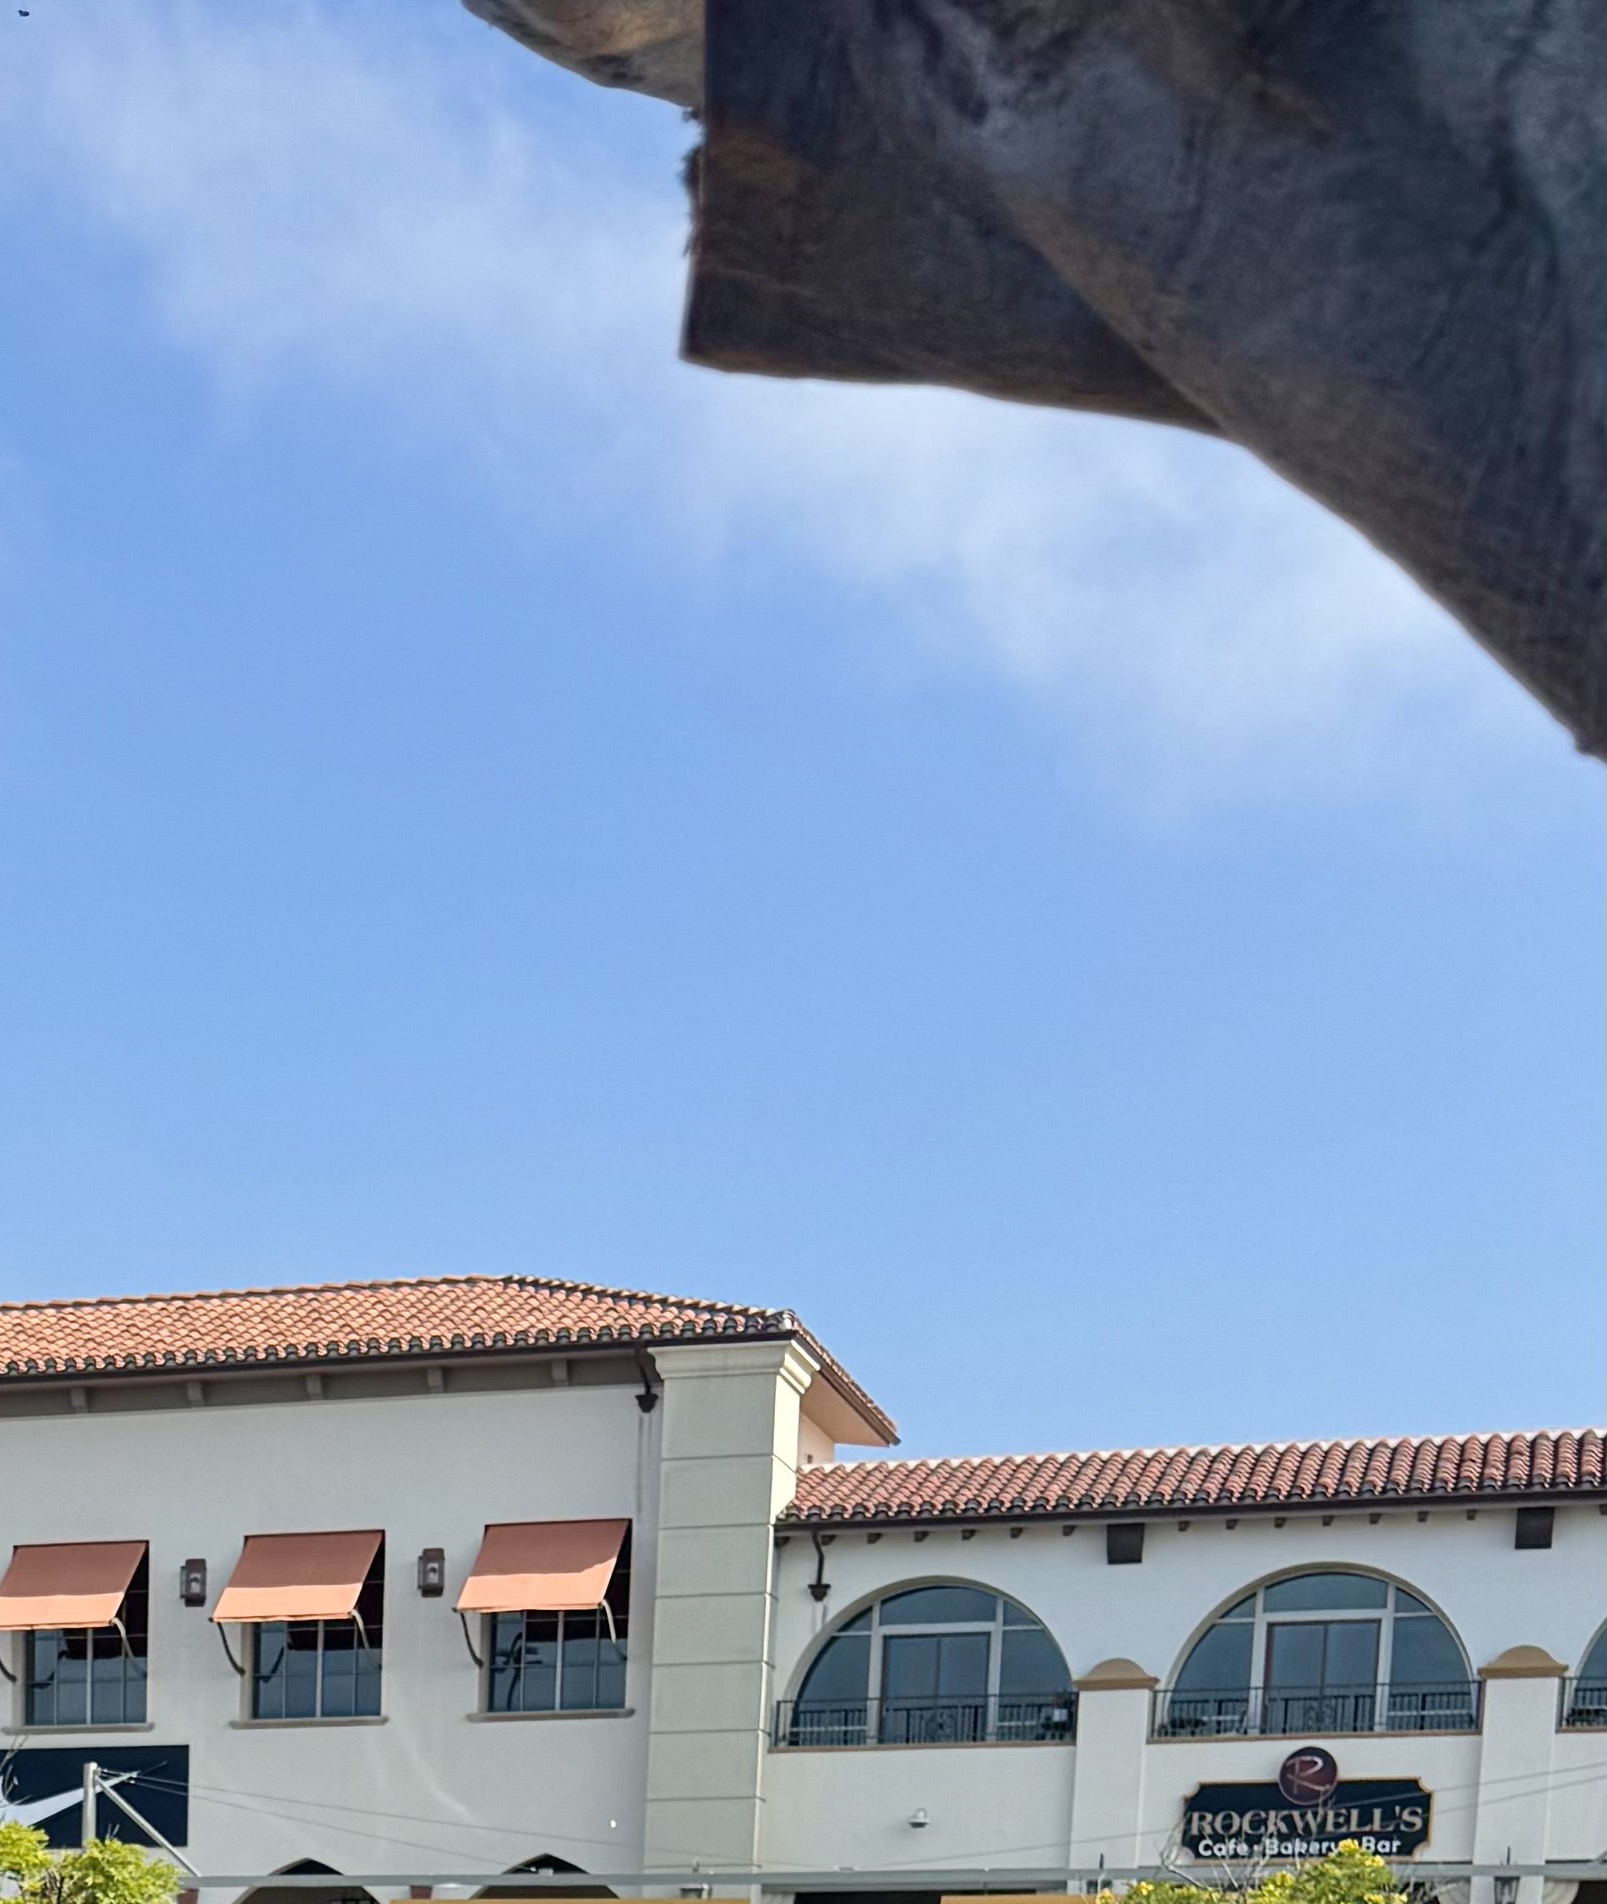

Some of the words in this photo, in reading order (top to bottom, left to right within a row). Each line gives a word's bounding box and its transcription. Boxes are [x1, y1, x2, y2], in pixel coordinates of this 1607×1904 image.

[1190, 1805, 1423, 1836] ROCKWELL'S
[1198, 1838, 1250, 1857] Cafe
[1361, 1836, 1401, 1854] Bar
